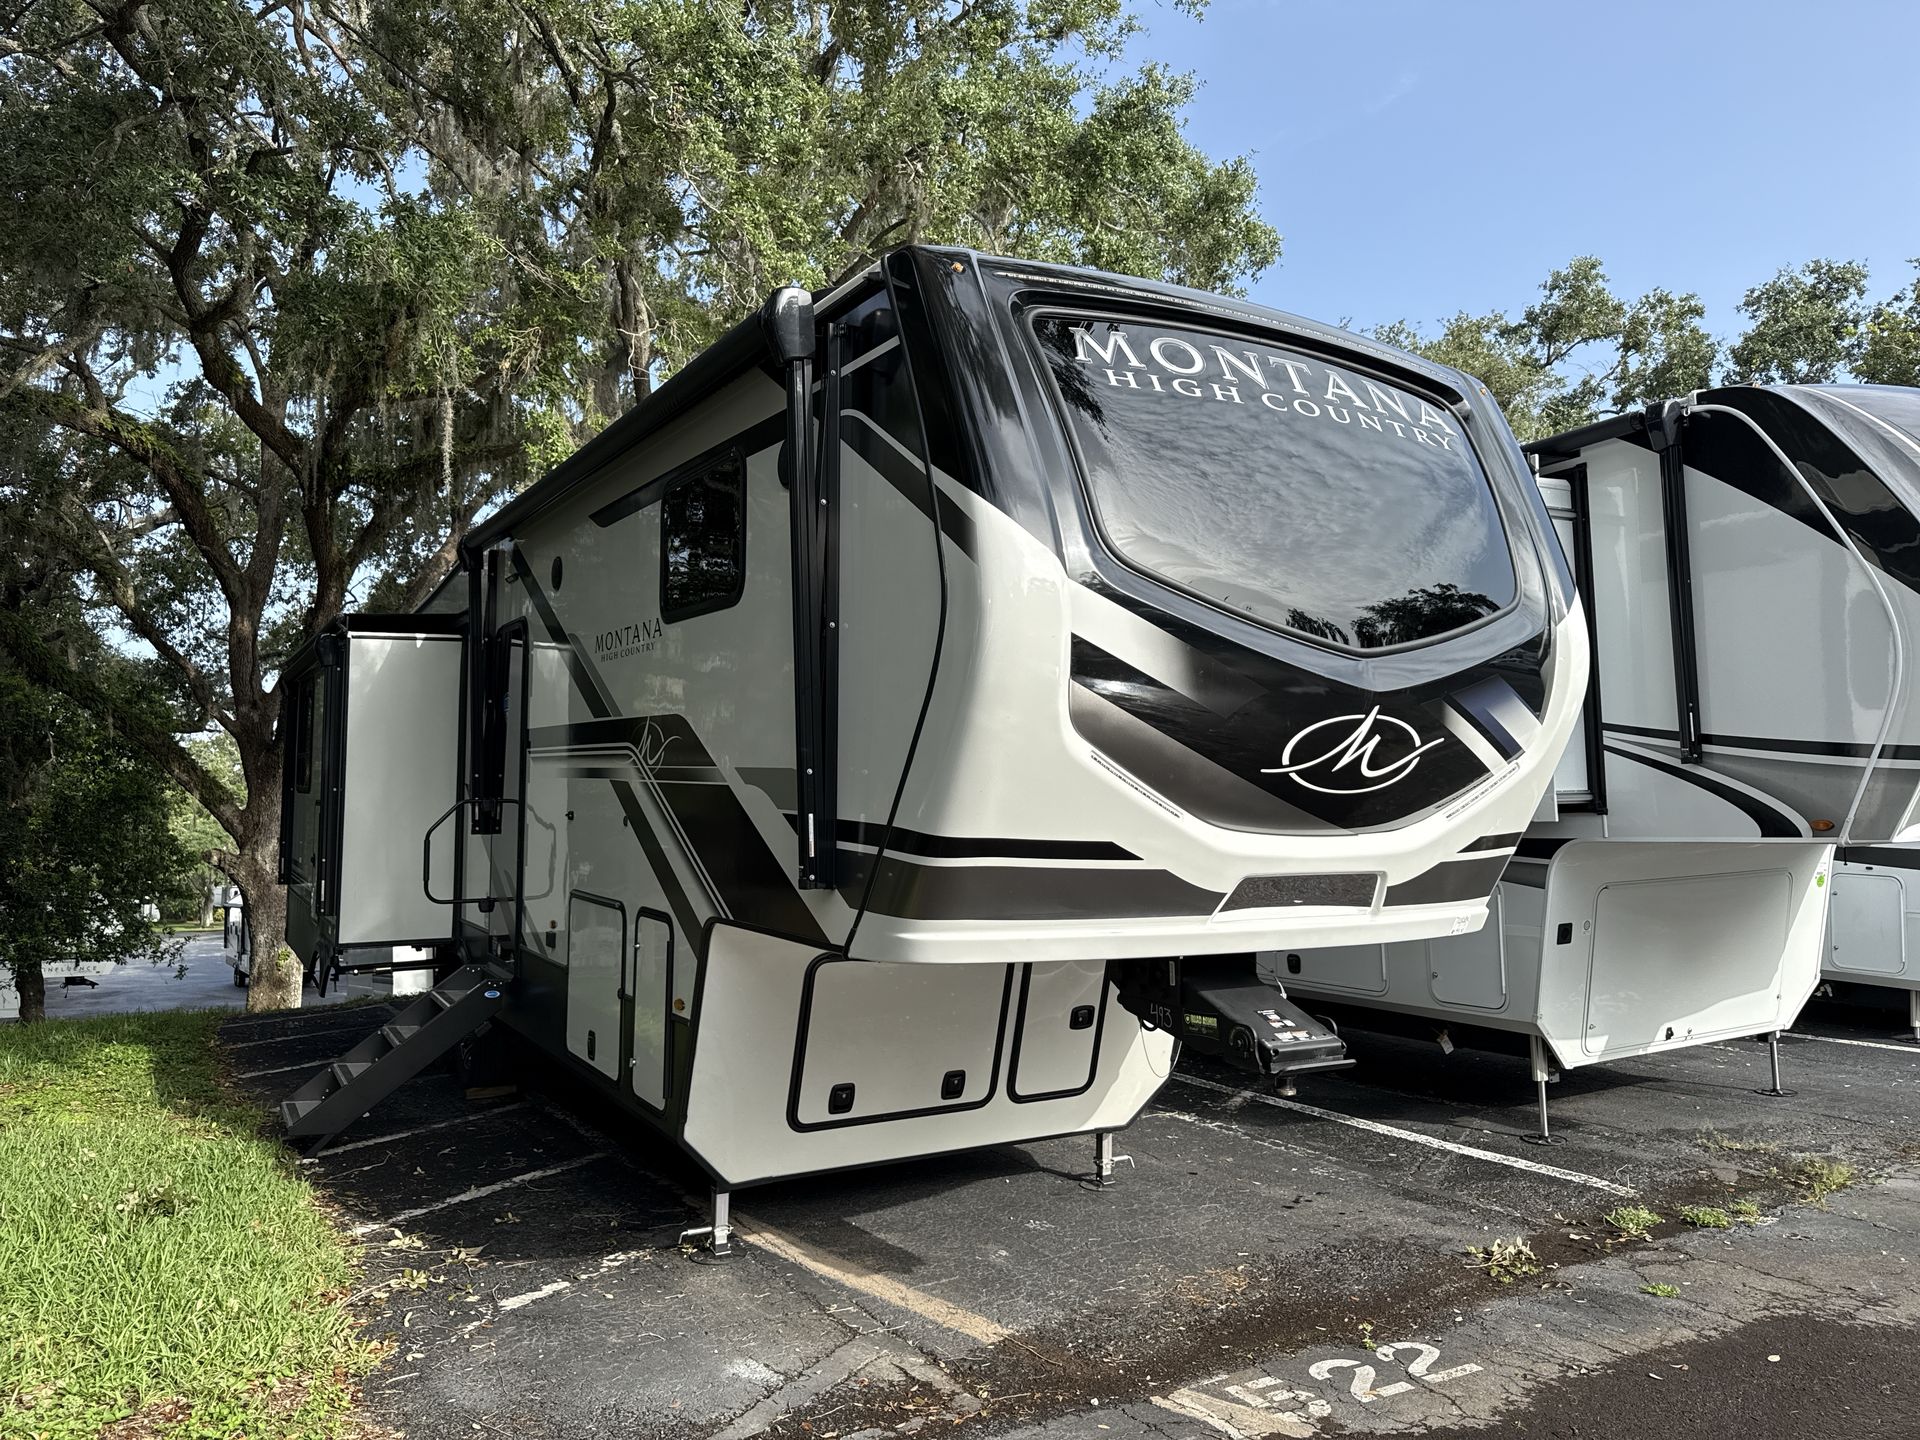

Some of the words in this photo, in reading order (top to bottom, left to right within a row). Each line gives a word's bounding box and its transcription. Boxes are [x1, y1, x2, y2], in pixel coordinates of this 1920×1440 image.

[1068, 327, 1458, 436] MONTANA
[1102, 368, 1245, 405] HIGH
[1262, 393, 1453, 451] COUNTRY
[594, 618, 662, 654] MONTANA
[600, 651, 619, 663] HIGH
[620, 641, 655, 658] COUNTRY
[1150, 1003, 1173, 1028] 493
